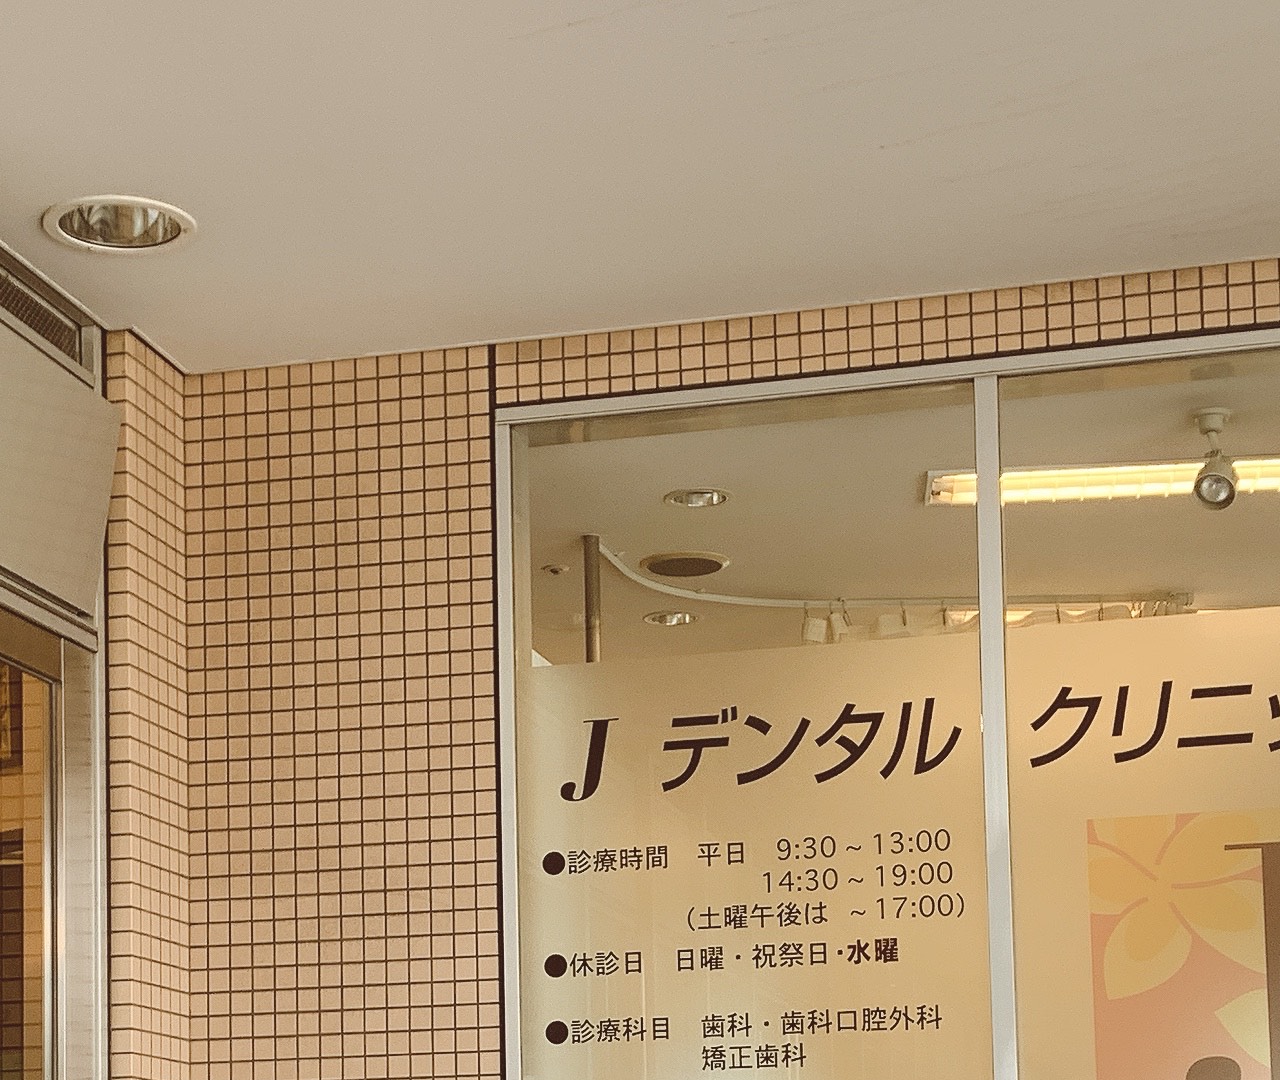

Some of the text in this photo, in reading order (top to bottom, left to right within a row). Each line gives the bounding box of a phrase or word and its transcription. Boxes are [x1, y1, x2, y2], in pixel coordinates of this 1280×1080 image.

[560, 717, 620, 802] J
[661, 697, 963, 793] デンタル
[568, 845, 669, 874] 診療時間
[697, 841, 746, 868] 平日
[570, 951, 643, 979] 休診日
[571, 1004, 943, 1044] 診療科目 歯科・歯科口腔外科
[701, 1043, 807, 1071] 矯正歯科
